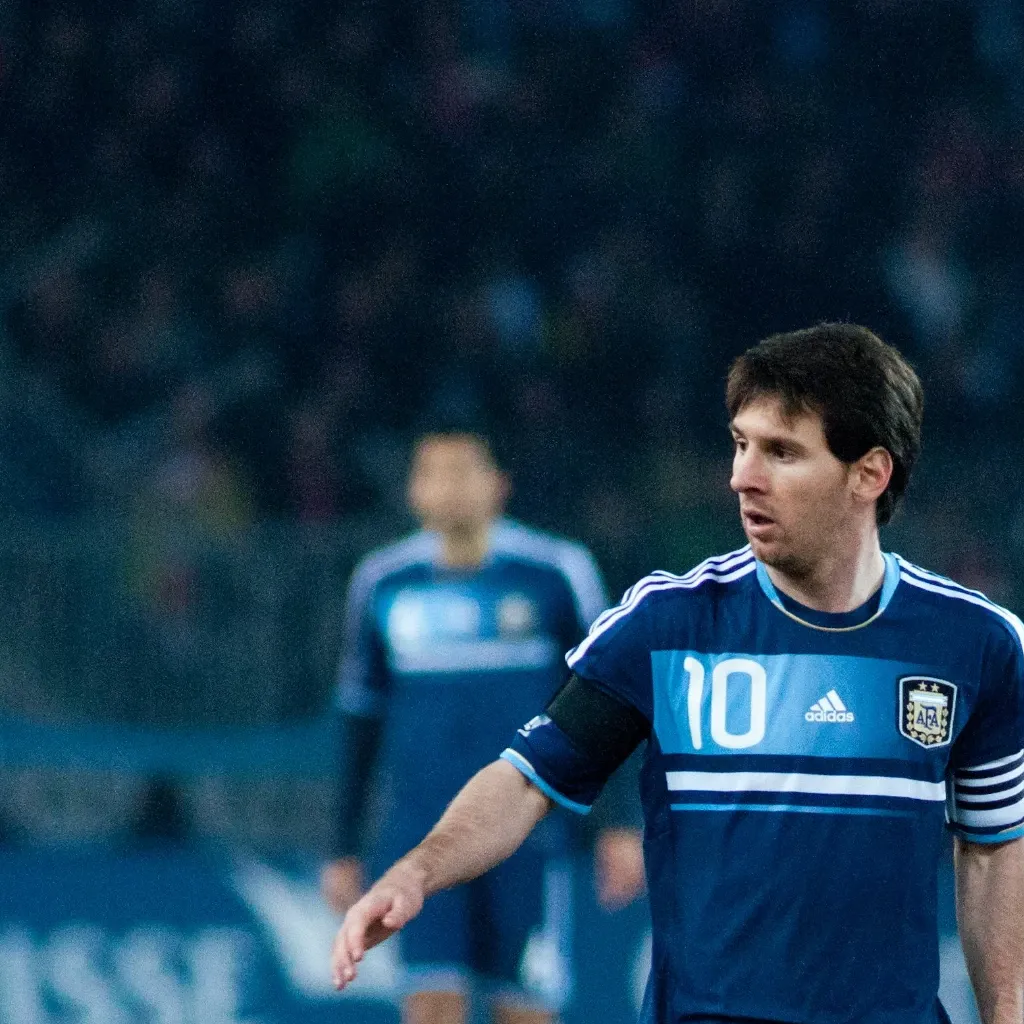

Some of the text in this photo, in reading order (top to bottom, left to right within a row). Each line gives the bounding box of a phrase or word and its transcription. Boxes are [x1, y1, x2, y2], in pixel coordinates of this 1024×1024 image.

[683, 656, 766, 749] 10
[805, 709, 854, 722] adidas
[916, 704, 939, 730] AFA
